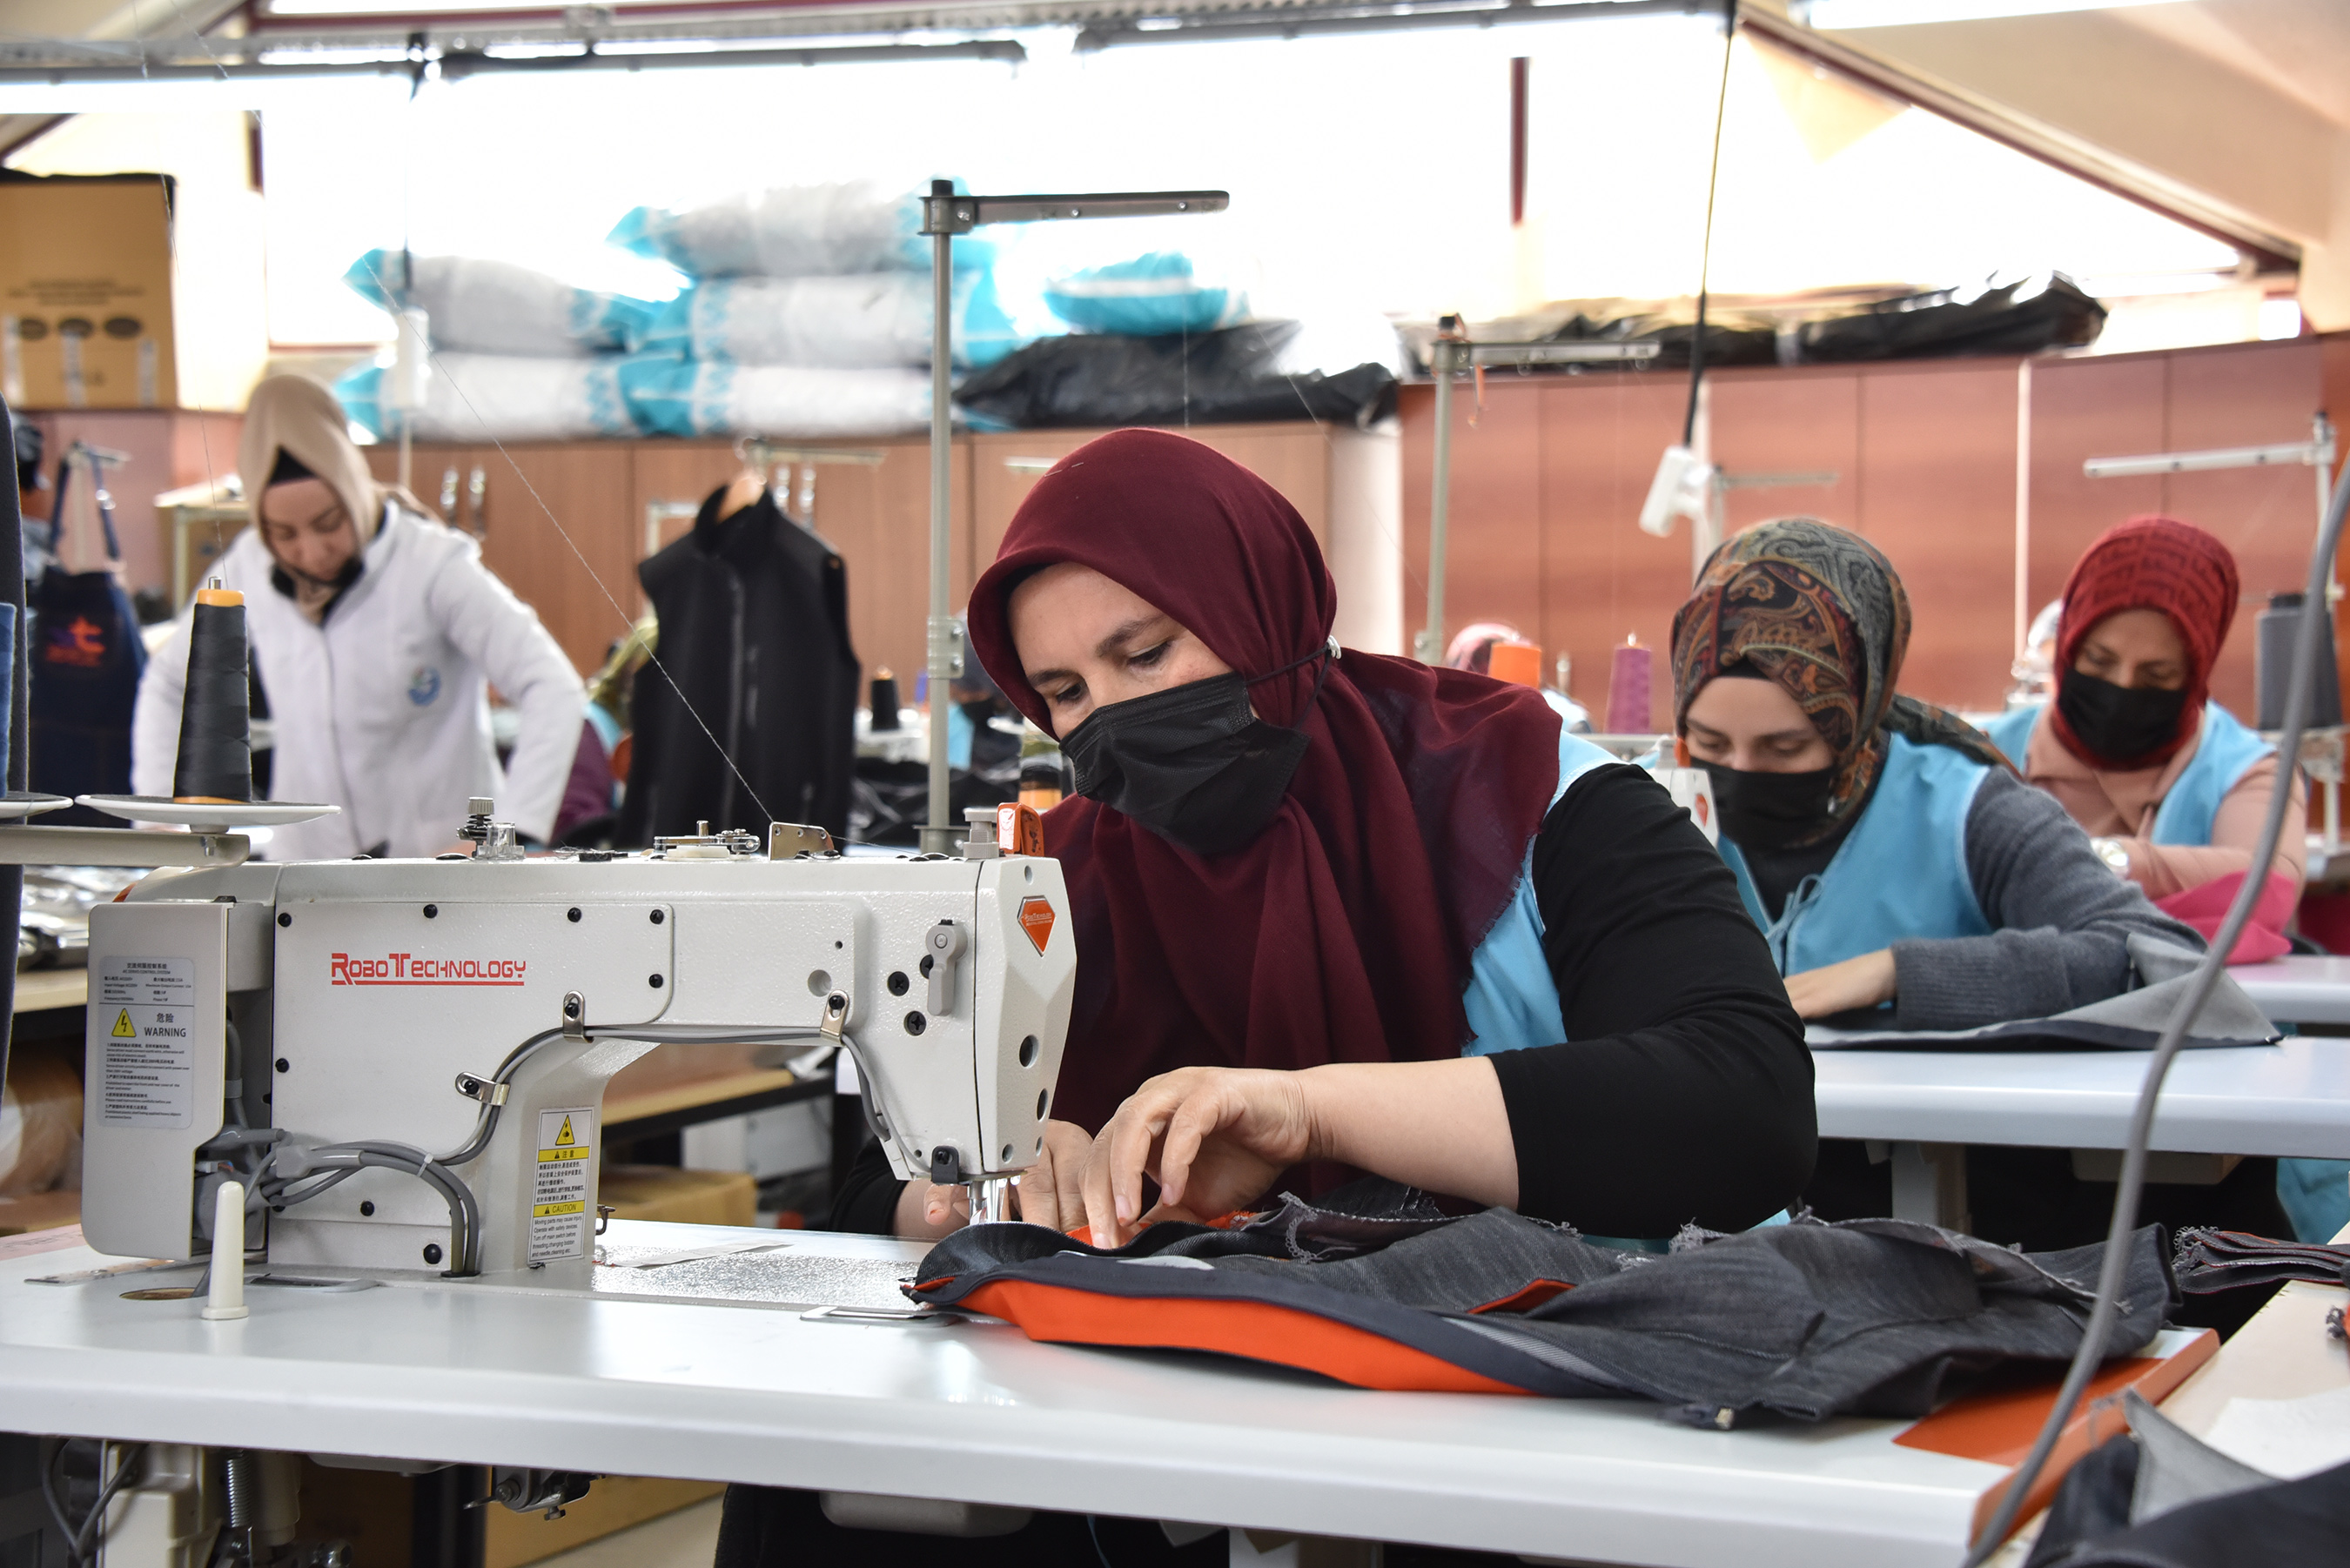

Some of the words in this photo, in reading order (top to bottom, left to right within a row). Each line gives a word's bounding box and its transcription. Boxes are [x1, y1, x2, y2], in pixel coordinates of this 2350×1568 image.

[156, 1012, 174, 1023] 危险
[144, 1027, 186, 1037] WARNING
[553, 1203, 576, 1213] CAUTION
